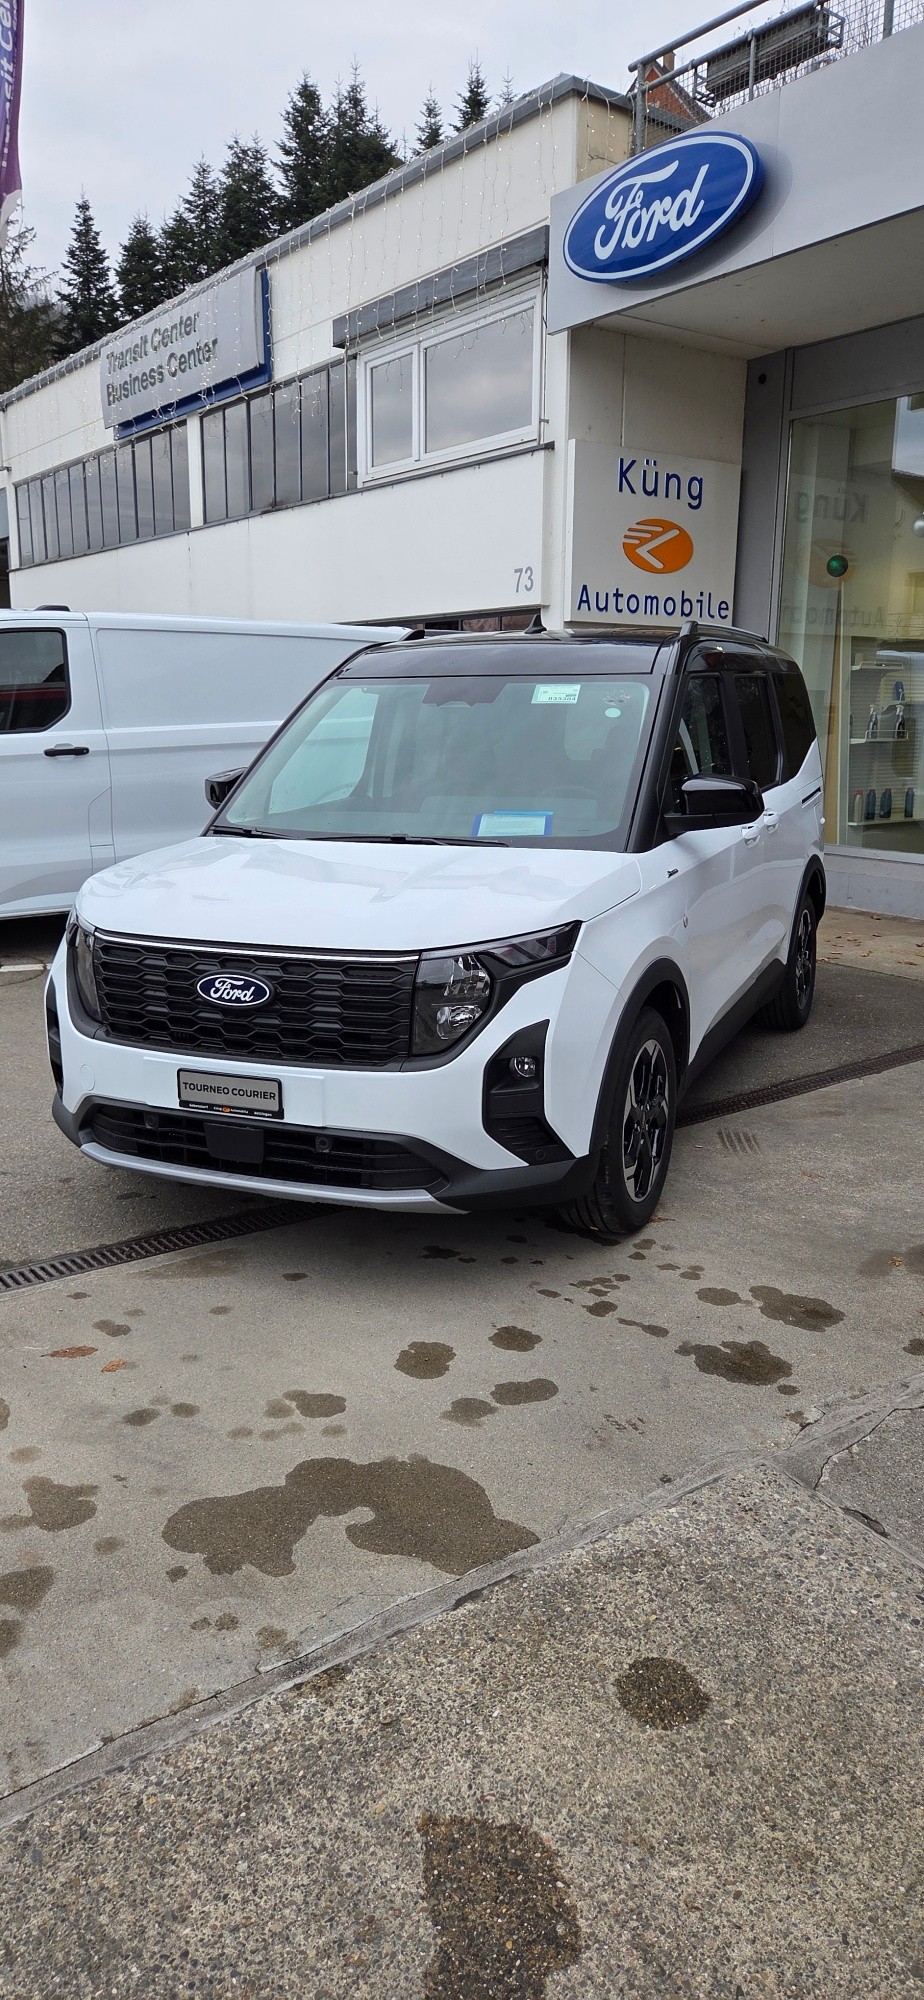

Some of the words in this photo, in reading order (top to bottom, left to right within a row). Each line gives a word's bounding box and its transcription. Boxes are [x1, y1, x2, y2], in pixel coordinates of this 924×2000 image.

[594, 160, 710, 260] Ford
[106, 335, 149, 374] Transit
[151, 311, 200, 352] Center
[106, 365, 164, 406] Business
[167, 337, 218, 377] Center
[618, 457, 704, 510] Küng
[513, 566, 534, 593] 73
[577, 584, 730, 620] Automobile
[210, 978, 255, 1001] Ford
[182, 1081, 230, 1095] TOURNEO
[231, 1087, 276, 1101] COURIER
